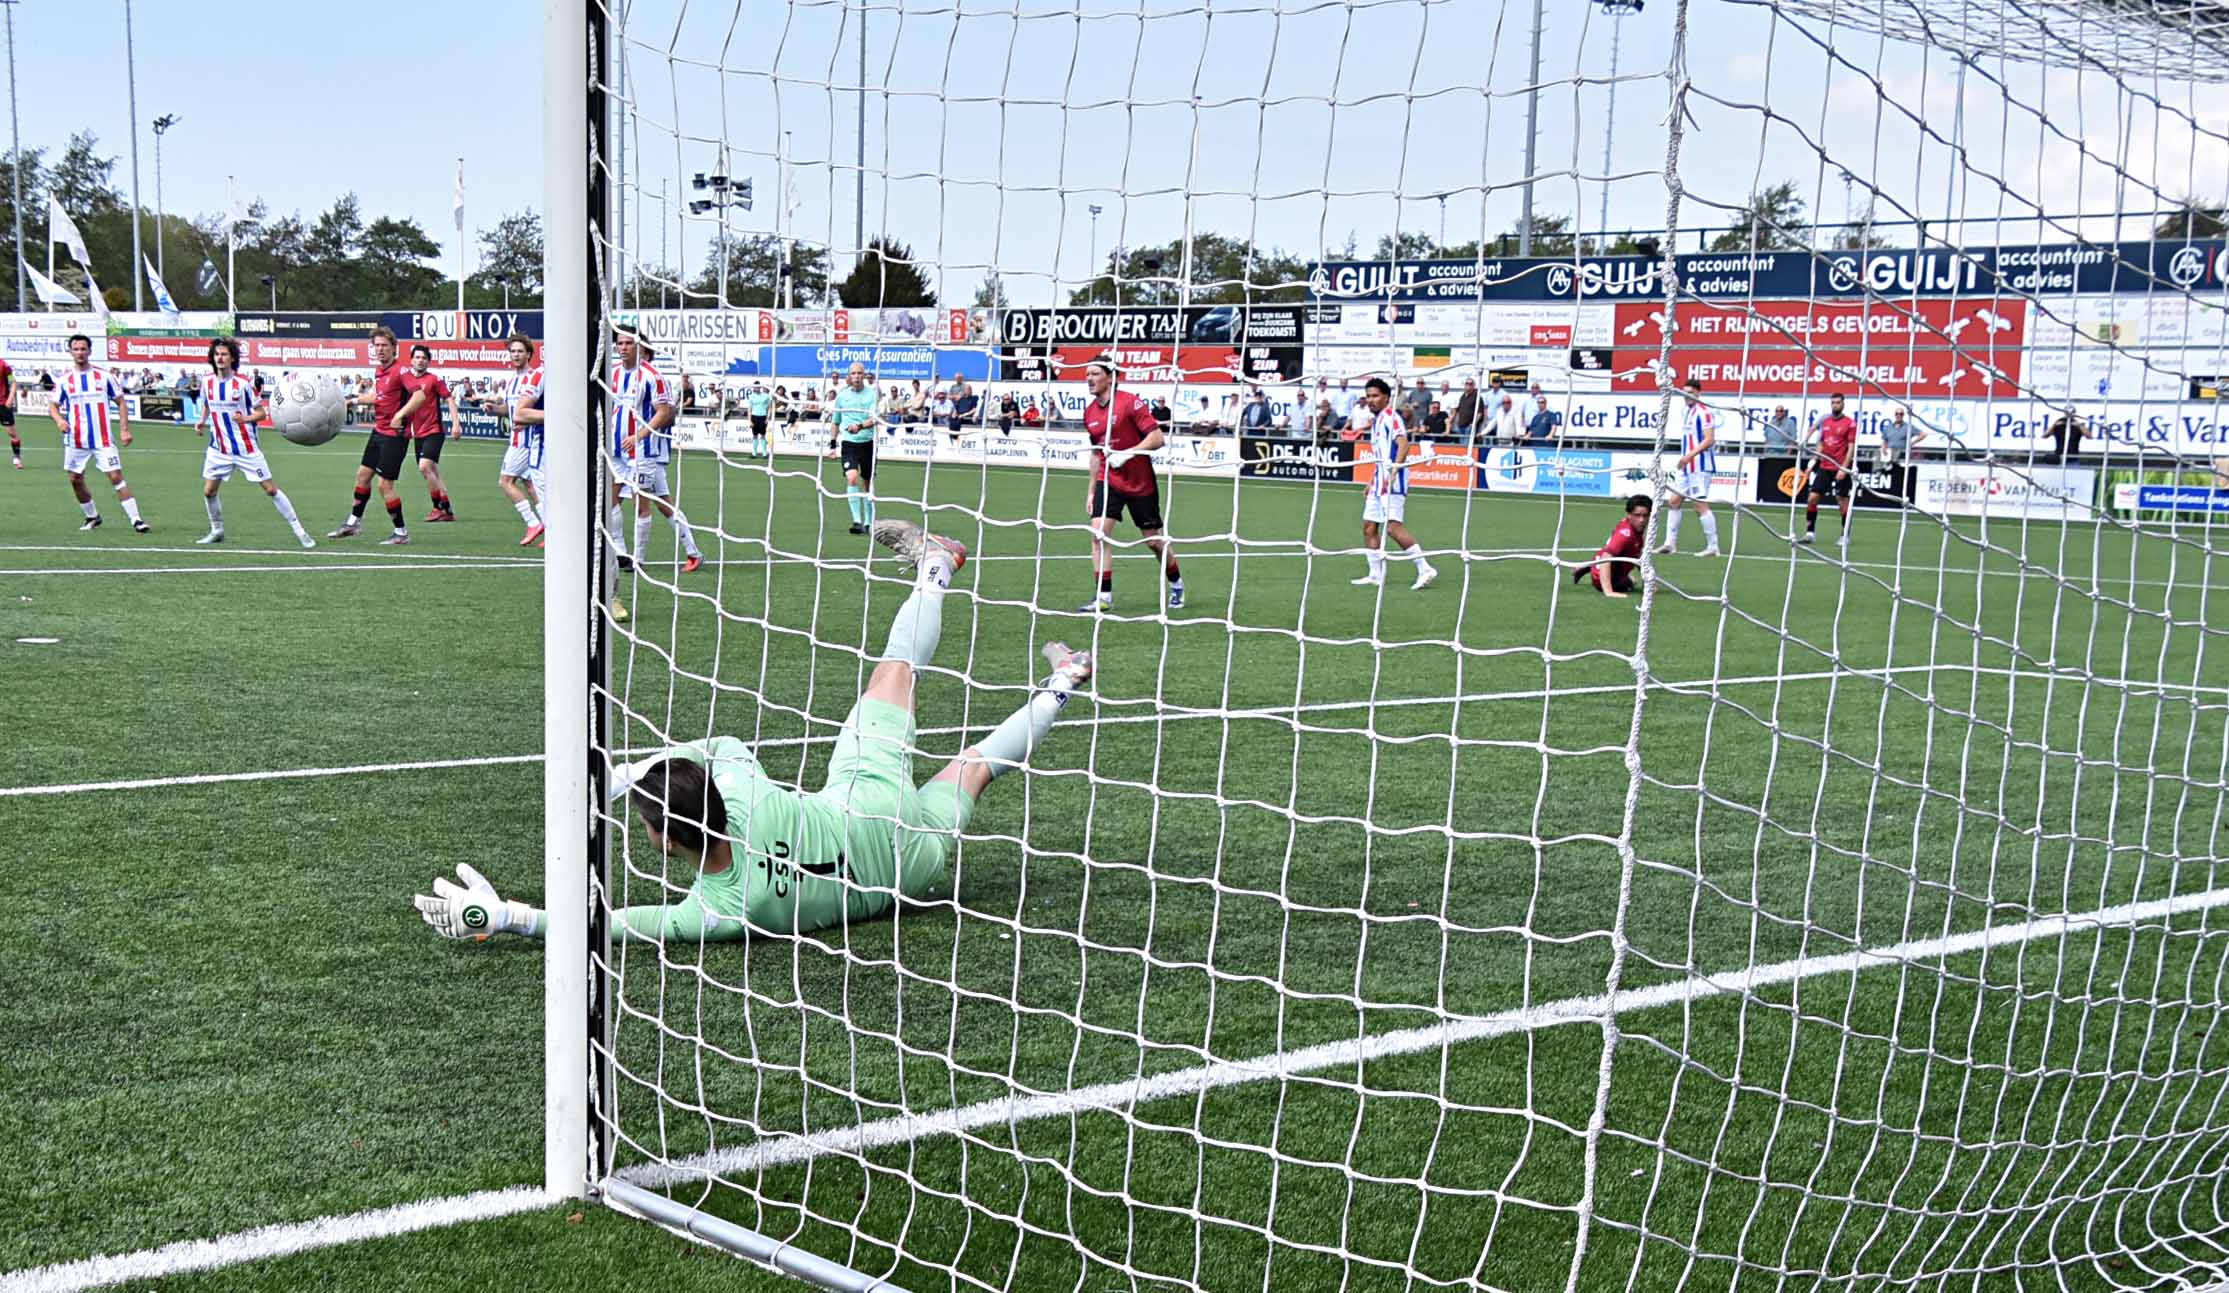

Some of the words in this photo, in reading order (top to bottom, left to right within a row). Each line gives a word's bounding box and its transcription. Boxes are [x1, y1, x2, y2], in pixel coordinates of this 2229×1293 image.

[1687, 255, 1775, 273] accountant
[2000, 249, 2104, 268] accountant
[1428, 262, 1502, 277] accountant
[1866, 254, 1985, 291] GUIJT
[1336, 265, 1420, 296] GUIJT
[1700, 276, 1749, 294] advies
[2013, 270, 2073, 289] advies
[1439, 283, 1480, 296] advies
[412, 313, 518, 338] EQUINOX
[646, 314, 748, 339] NOTARISSEN
[1036, 315, 1148, 339] BROUWER
[1150, 314, 1189, 332] TAXI
[1248, 327, 1297, 337] TOEKOMST!
[1691, 316, 1722, 333] HET
[1724, 316, 1829, 333] RIJNVOGELS
[438, 348, 459, 365] gaan
[459, 347, 478, 360] voor
[842, 347, 871, 365] Pronk
[1127, 351, 1162, 364] TEAM
[1249, 348, 1270, 359] WIJ
[1252, 359, 1278, 371] ZIJN
[1688, 364, 1719, 382] HET
[1722, 364, 1825, 382] RIJNVOGELS
[1829, 366, 1928, 383] GEVOEL.NL
[1058, 391, 1086, 411] Van
[1571, 405, 1611, 428] der
[1616, 405, 1662, 429] Plas
[1993, 412, 2135, 441] Parlliet
[2146, 416, 2172, 442] &
[1207, 451, 1227, 461] DBT
[1272, 445, 1293, 465] DE
[1297, 446, 1339, 467] JONG
[1928, 479, 1977, 494] REDERIJ
